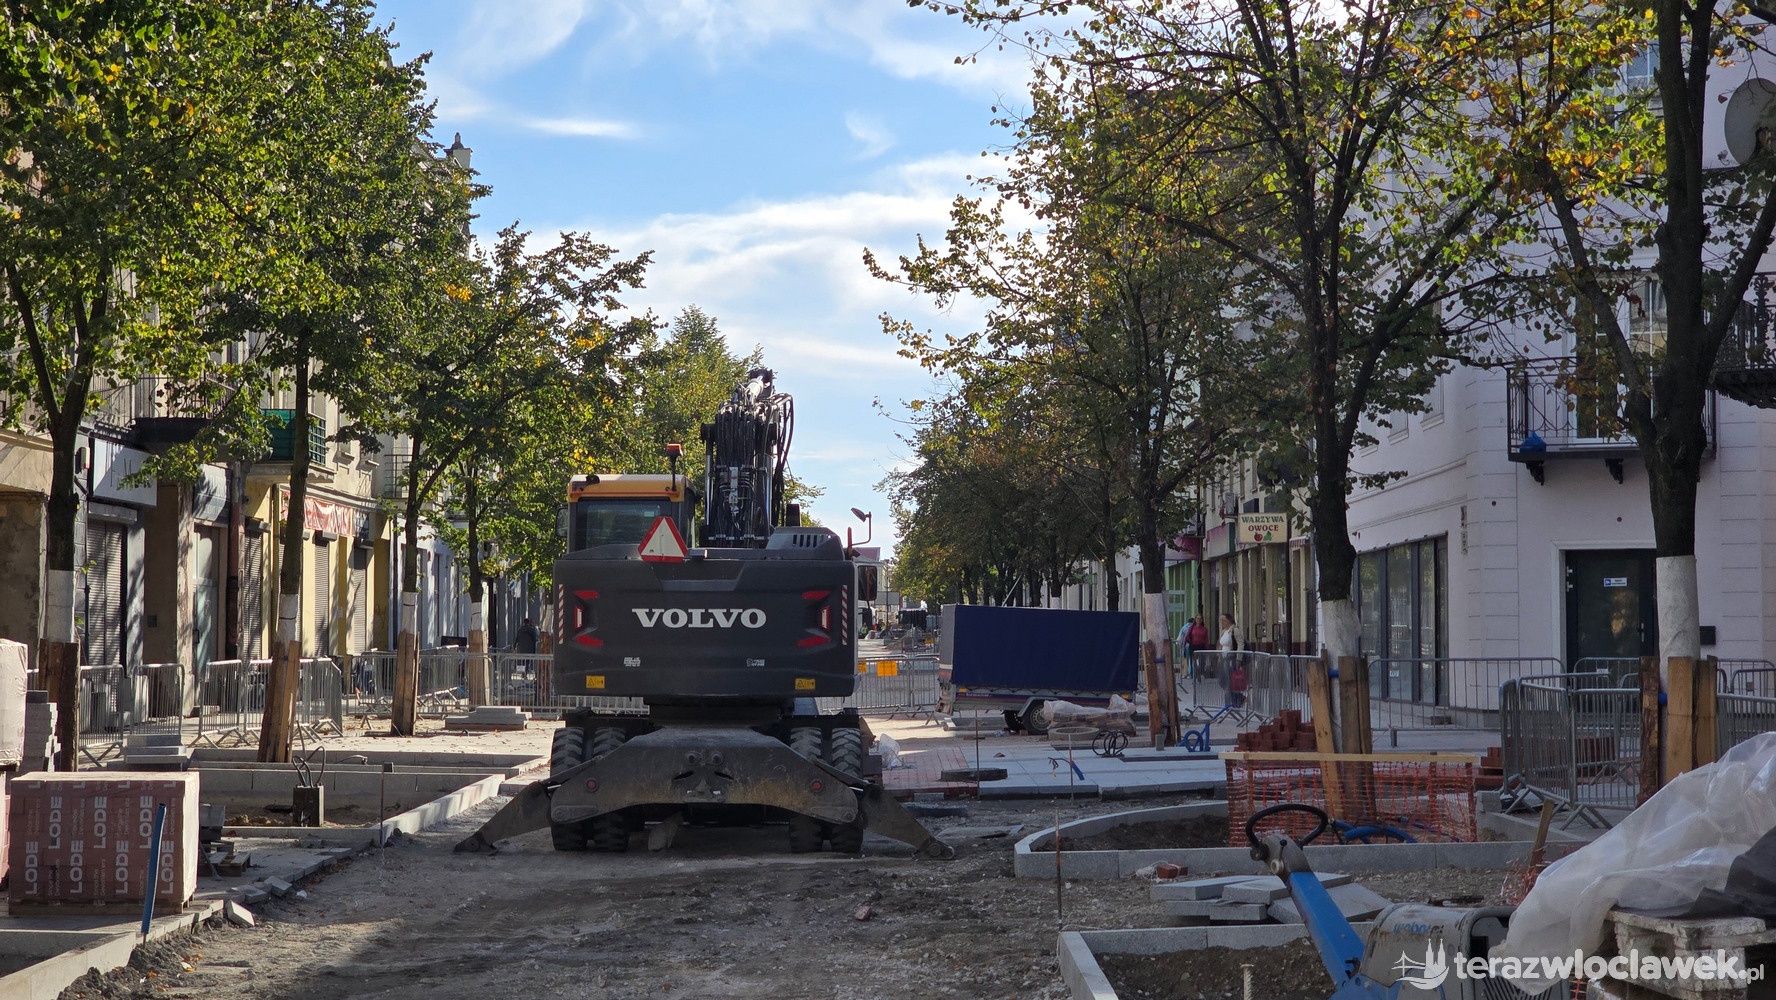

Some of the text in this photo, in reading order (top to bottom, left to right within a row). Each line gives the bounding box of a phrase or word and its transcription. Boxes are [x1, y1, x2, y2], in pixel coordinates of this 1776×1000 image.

[1241, 516, 1285, 524] WARZYWA
[1248, 524, 1279, 532] OWOCE
[631, 608, 767, 629] VOLVO
[48, 796, 63, 850] LODE
[93, 796, 107, 849] LODE
[139, 796, 153, 849] LODE
[25, 841, 39, 895] LODE
[70, 840, 84, 894] LODE
[115, 840, 129, 894] LODE
[161, 840, 175, 894] LODE
